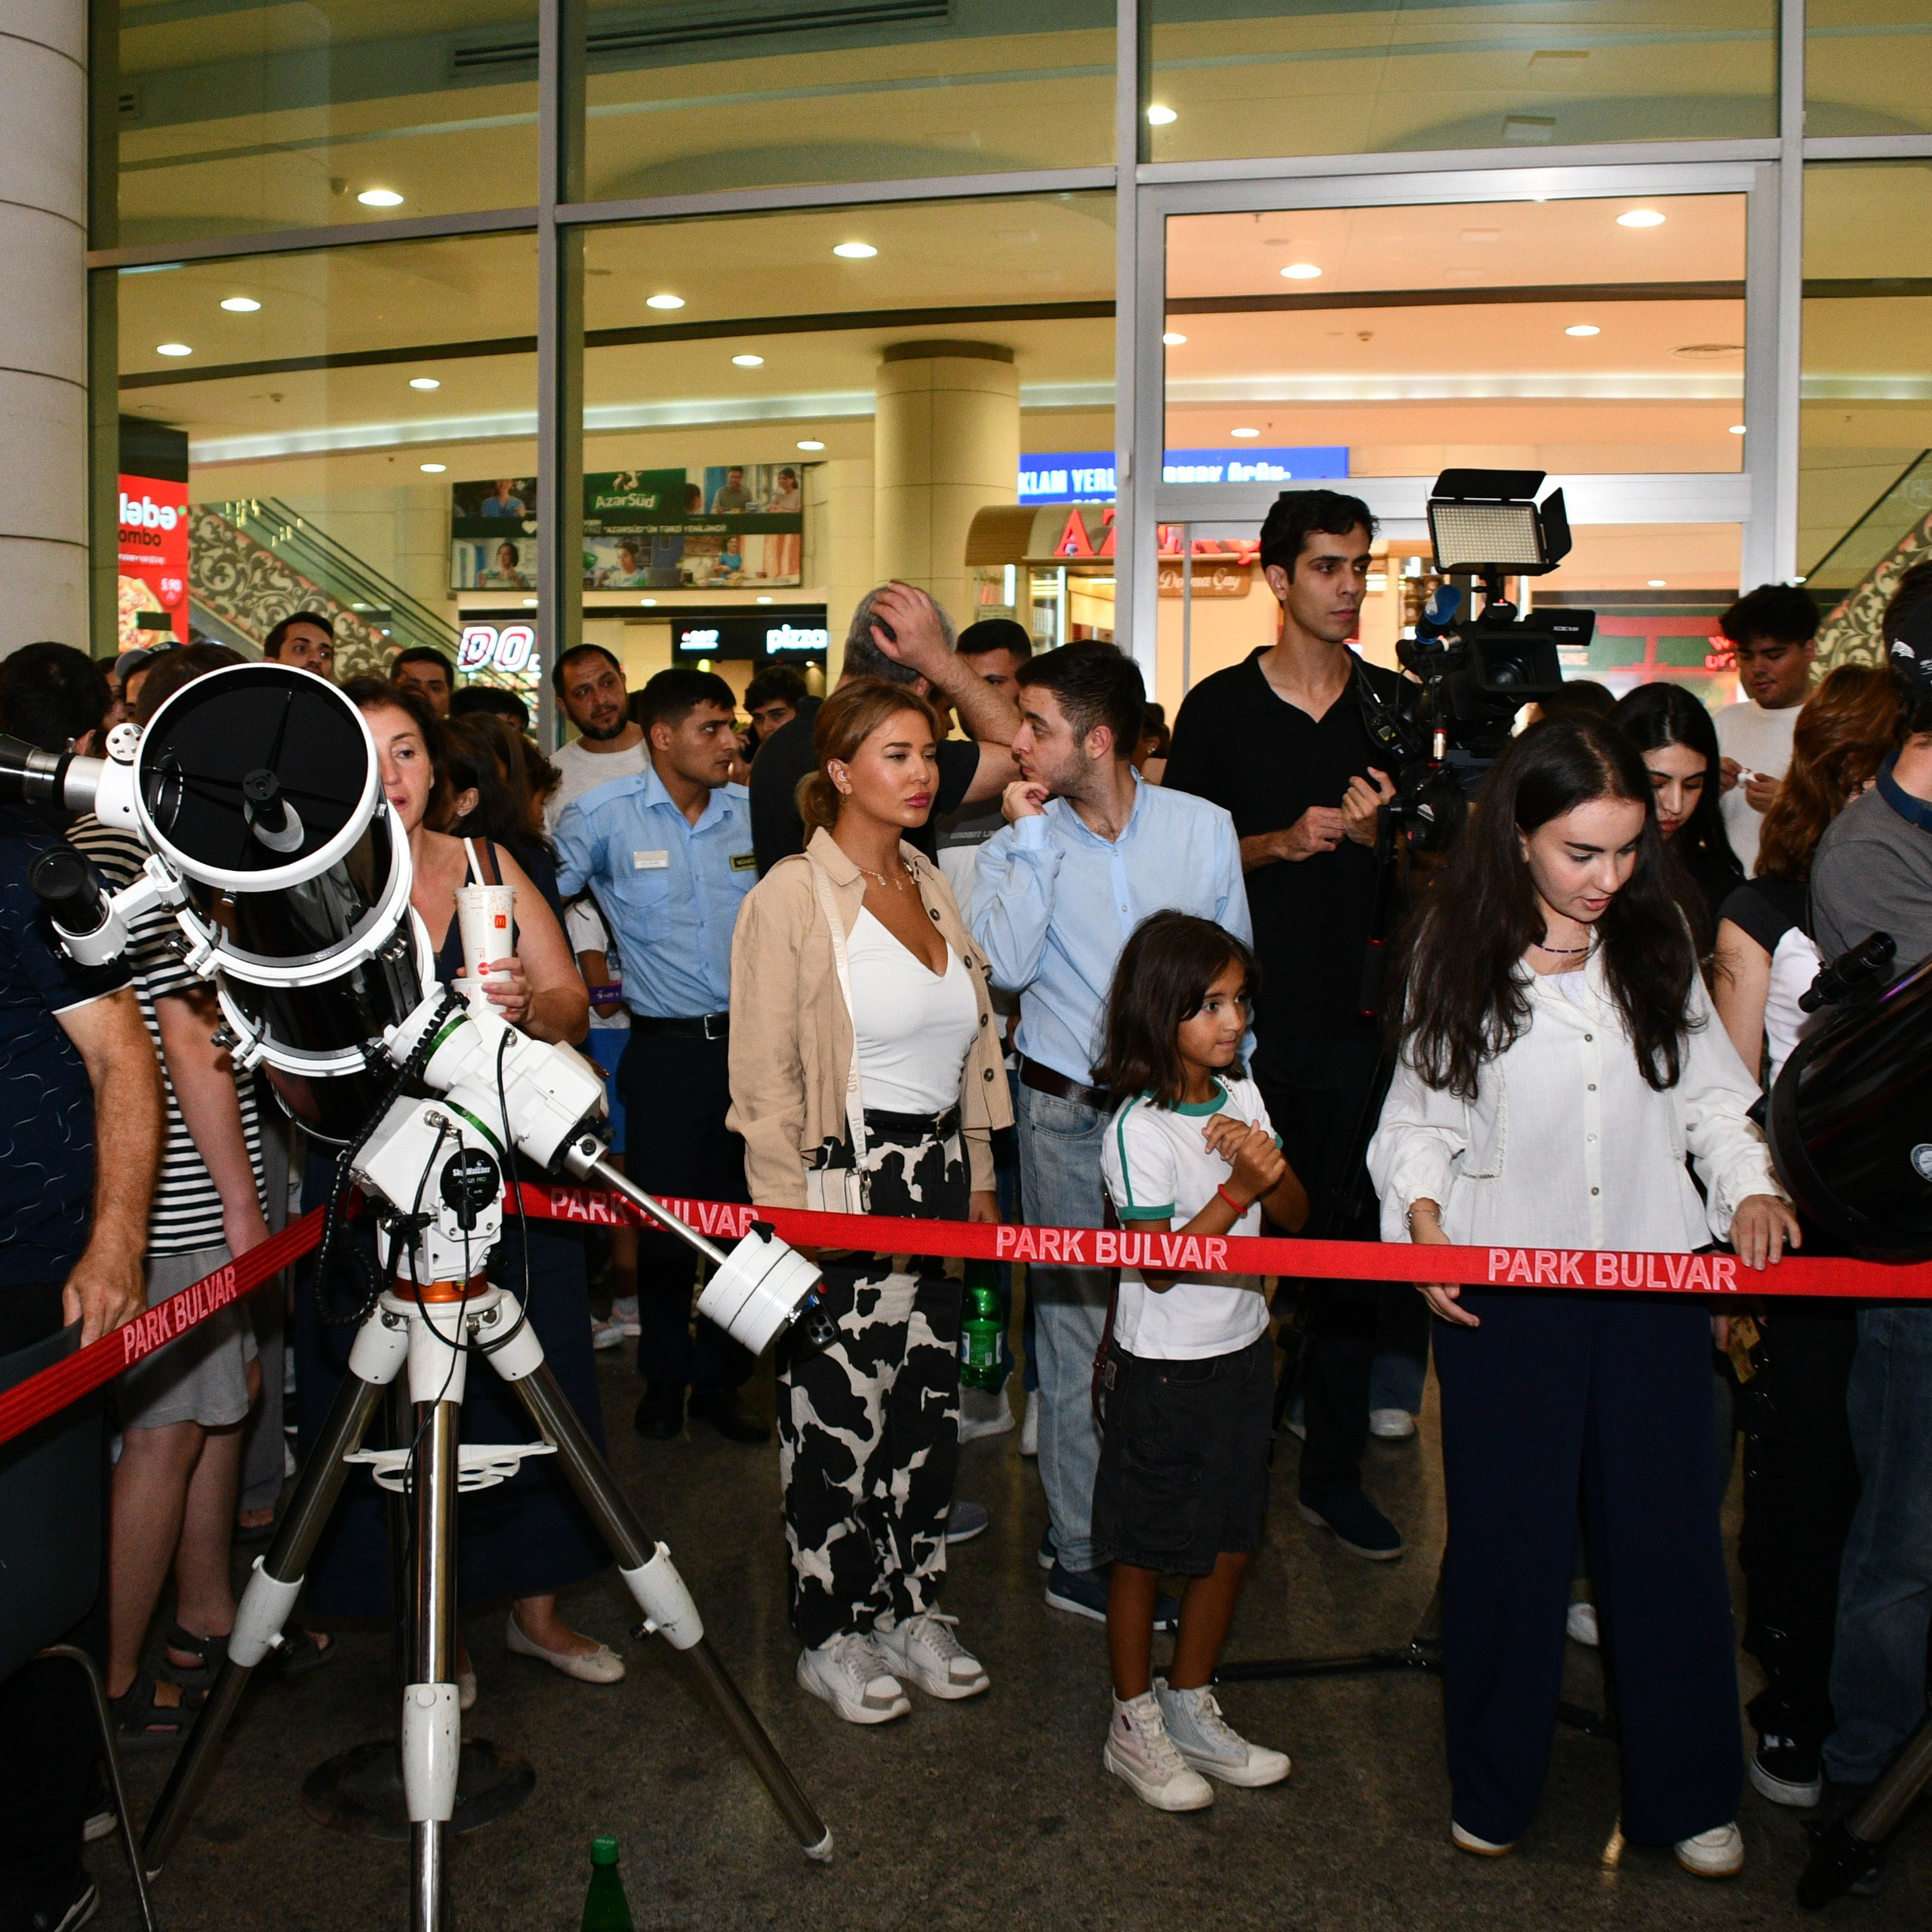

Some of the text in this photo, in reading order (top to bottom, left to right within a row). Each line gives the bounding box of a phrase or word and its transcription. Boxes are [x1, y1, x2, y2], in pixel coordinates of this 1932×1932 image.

[1018, 469, 1068, 495] KLAM
[119, 492, 177, 531] ləbə
[118, 529, 162, 547] ombo
[550, 1187, 629, 1225] PARK
[996, 1226, 1229, 1271] PARK BULVAR
[1488, 1248, 1737, 1291] PARK BULVAR
[122, 1265, 237, 1364] PARK BULVAR
